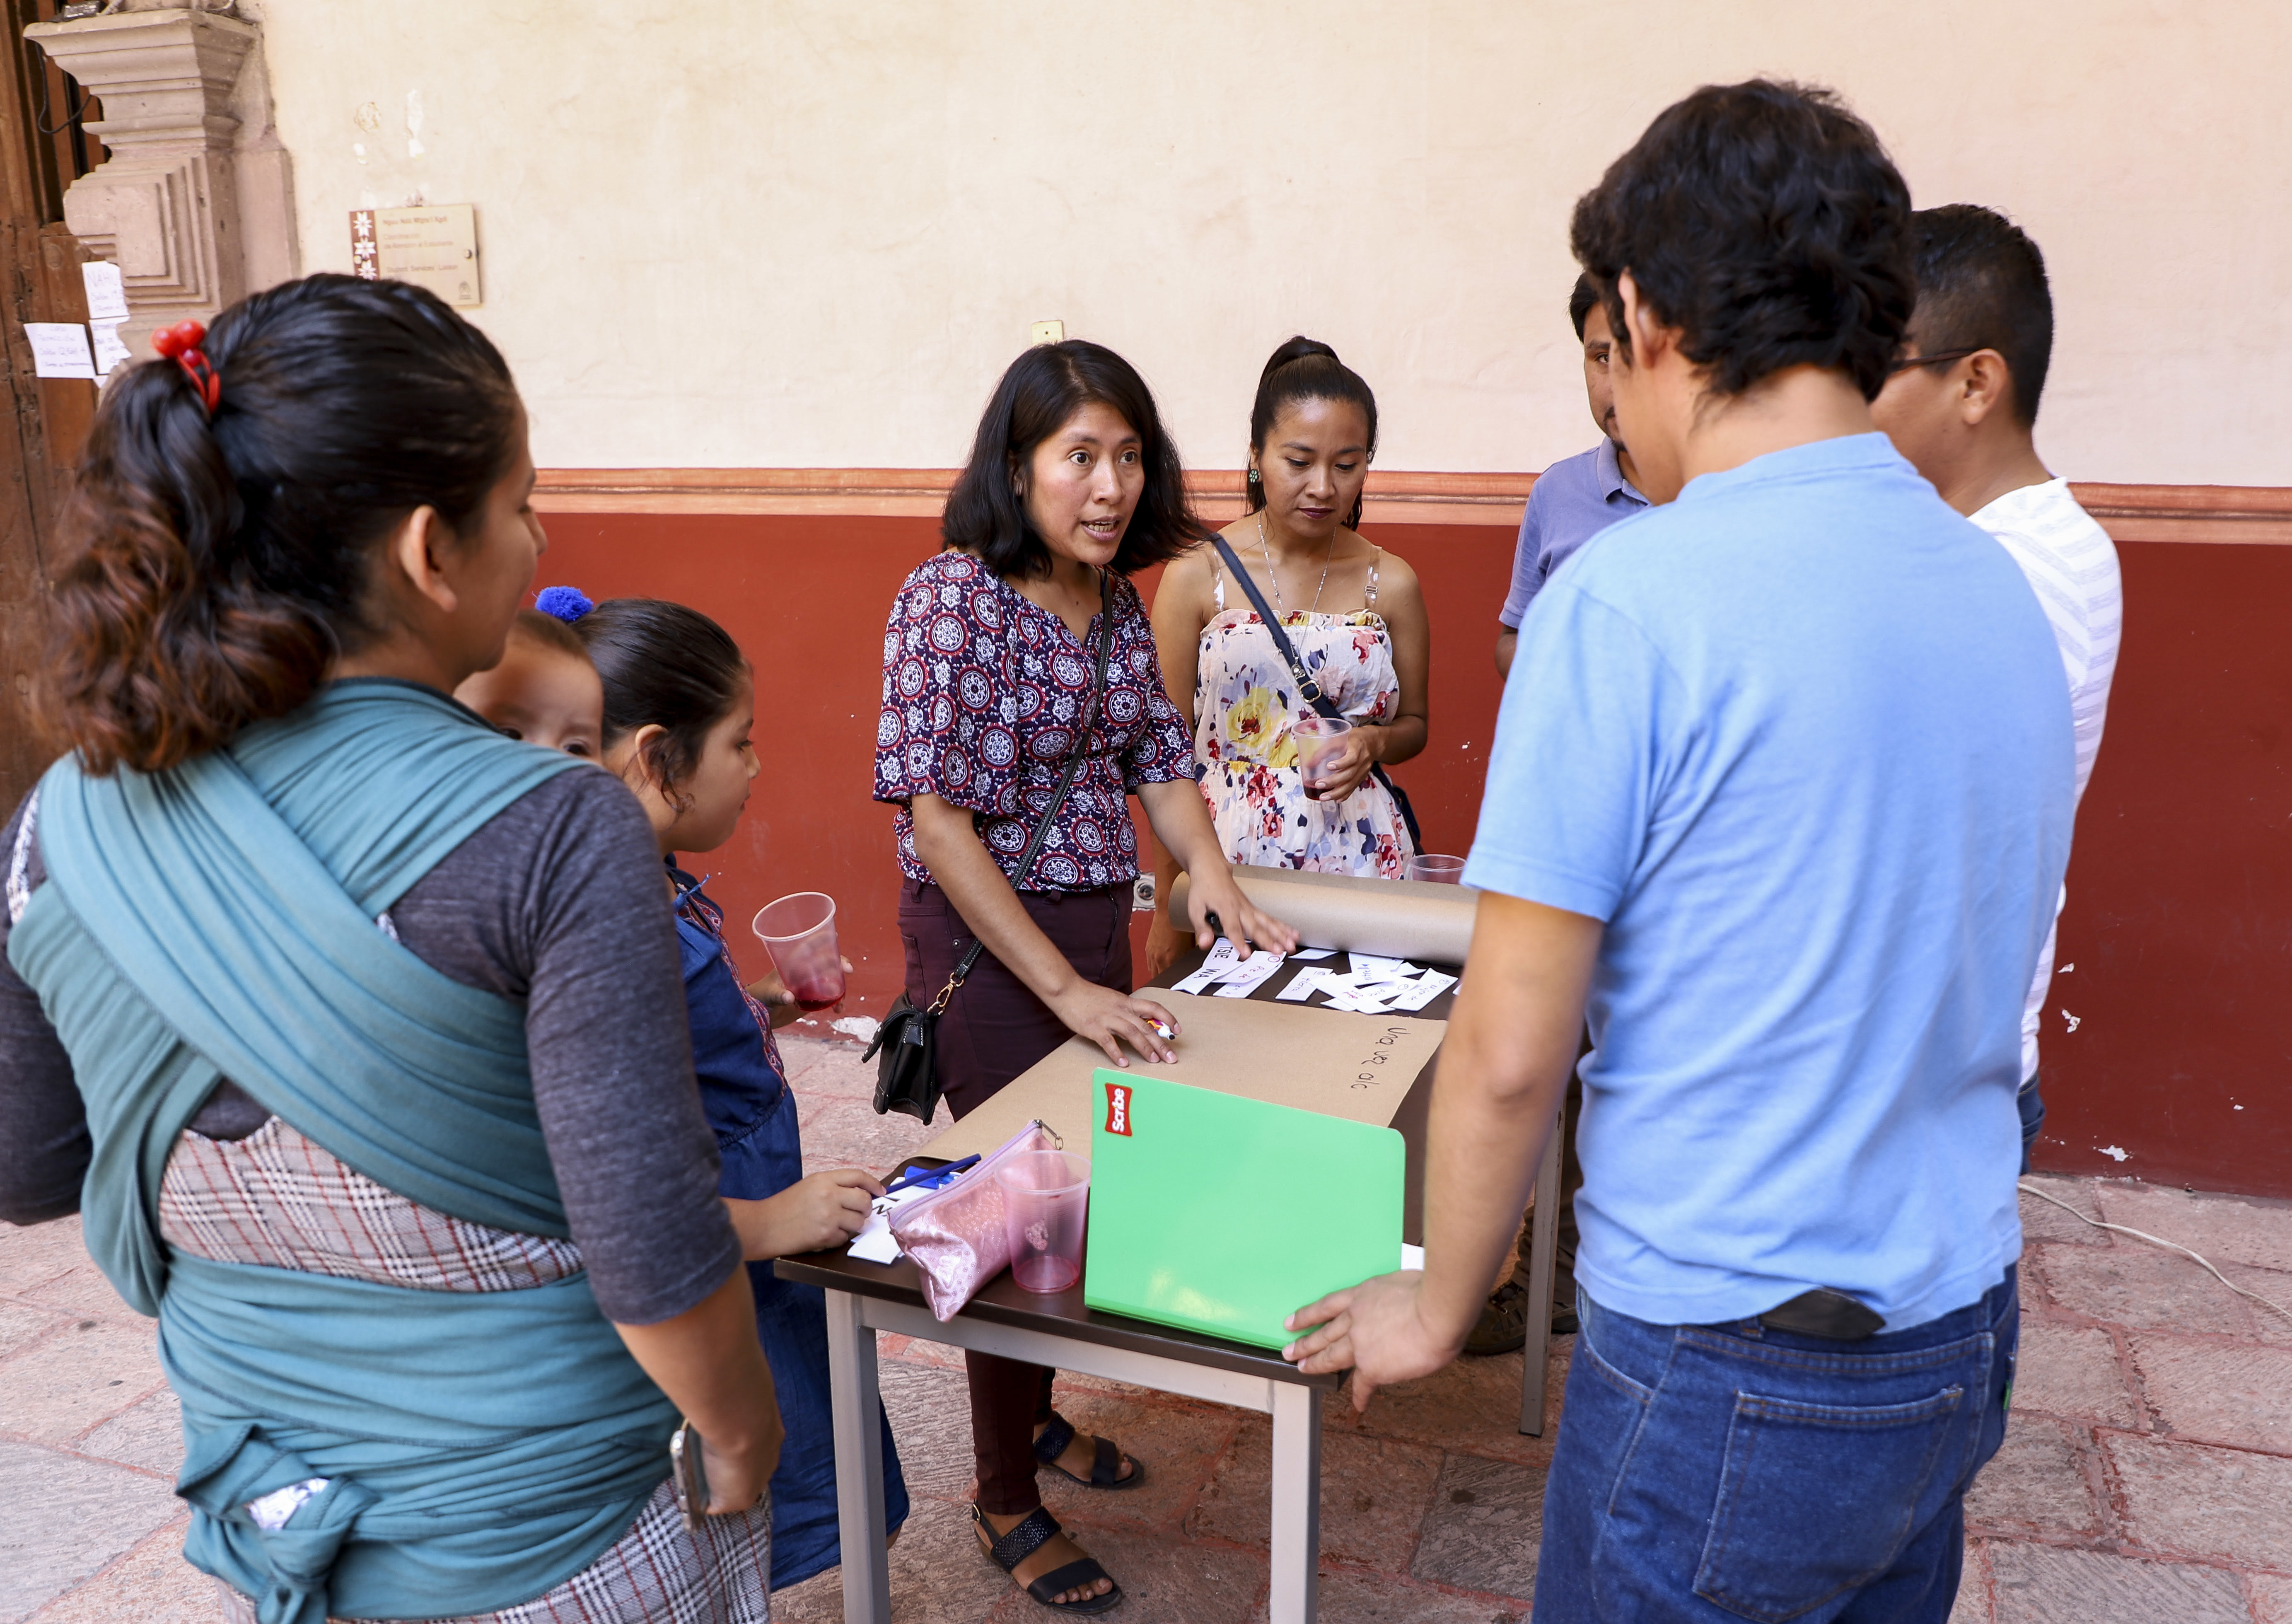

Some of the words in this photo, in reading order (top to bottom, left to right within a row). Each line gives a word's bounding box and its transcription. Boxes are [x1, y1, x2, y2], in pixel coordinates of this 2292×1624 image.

[1375, 1027, 1411, 1045] Una
[1361, 1050, 1390, 1065] vez
[1111, 1088, 1125, 1133] Scribe
